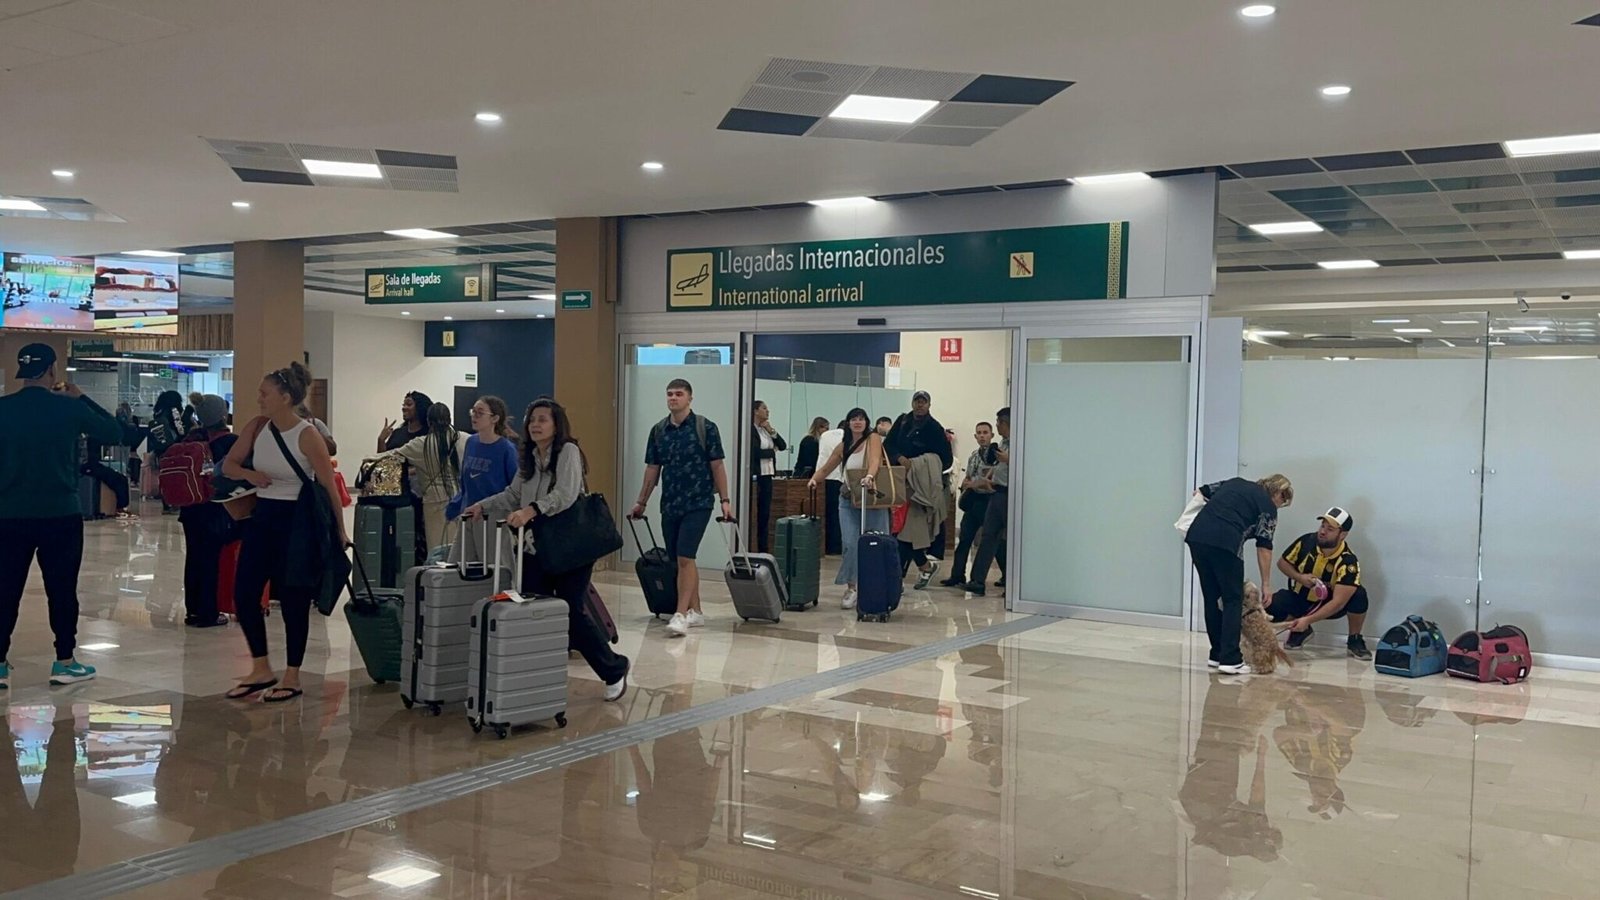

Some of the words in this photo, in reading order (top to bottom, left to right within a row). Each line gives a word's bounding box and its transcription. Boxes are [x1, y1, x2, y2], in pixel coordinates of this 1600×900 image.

[719, 248, 794, 279] Llegadas
[800, 239, 945, 270] Internacionales
[385, 274, 399, 286] Sala
[401, 273, 410, 285] de
[411, 272, 441, 287] llegadas
[385, 288, 402, 297] Arrival
[403, 287, 414, 297] hall
[719, 283, 811, 306] International
[816, 281, 864, 302] arrival
